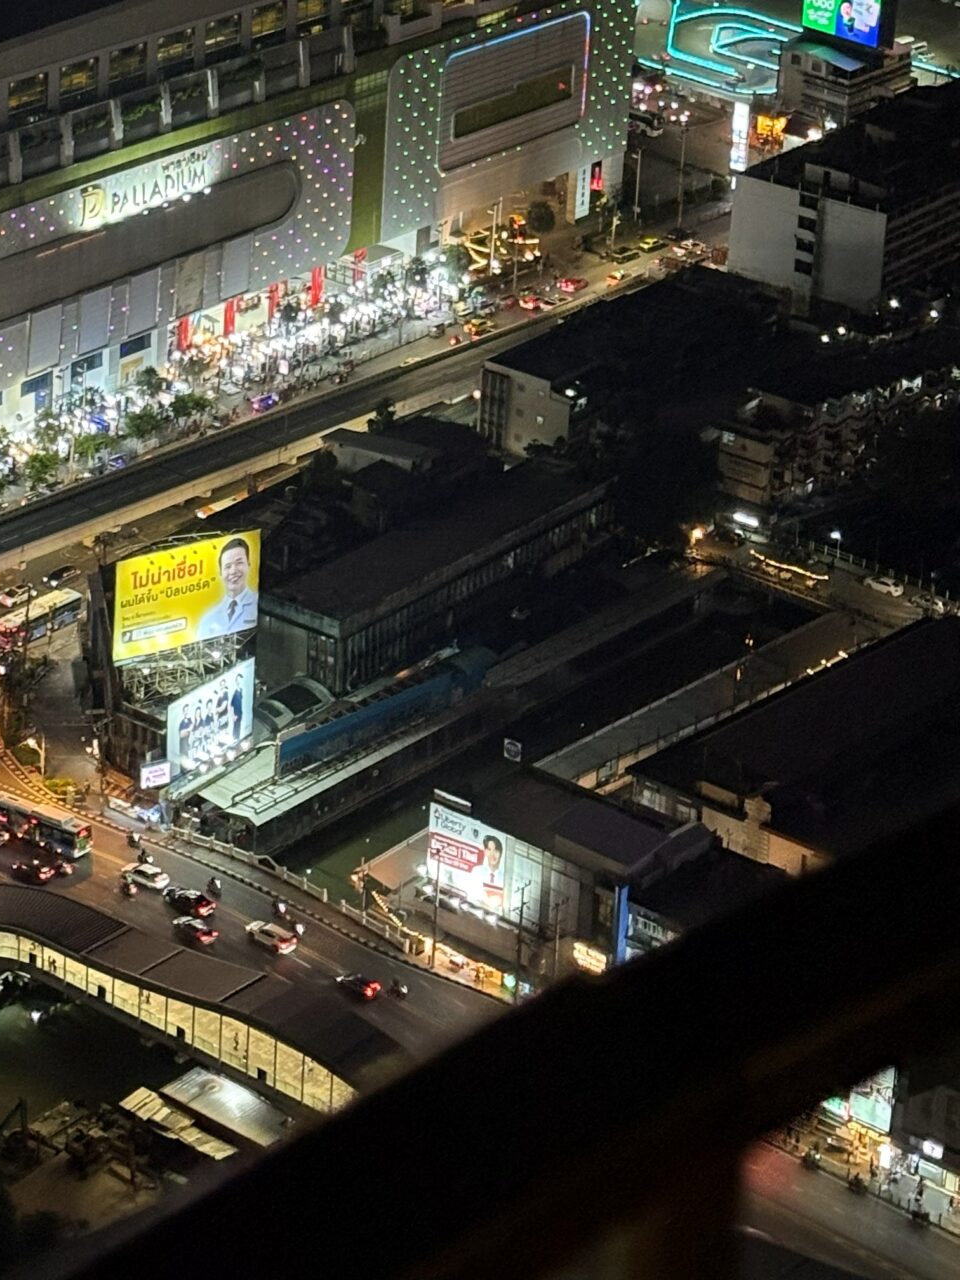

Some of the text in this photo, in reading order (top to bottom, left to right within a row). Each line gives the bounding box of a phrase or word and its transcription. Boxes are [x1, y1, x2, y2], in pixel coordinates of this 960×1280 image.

[111, 164, 206, 214] PALLADIUM
[131, 555, 204, 590] ไม่น่าเชื่อ!
